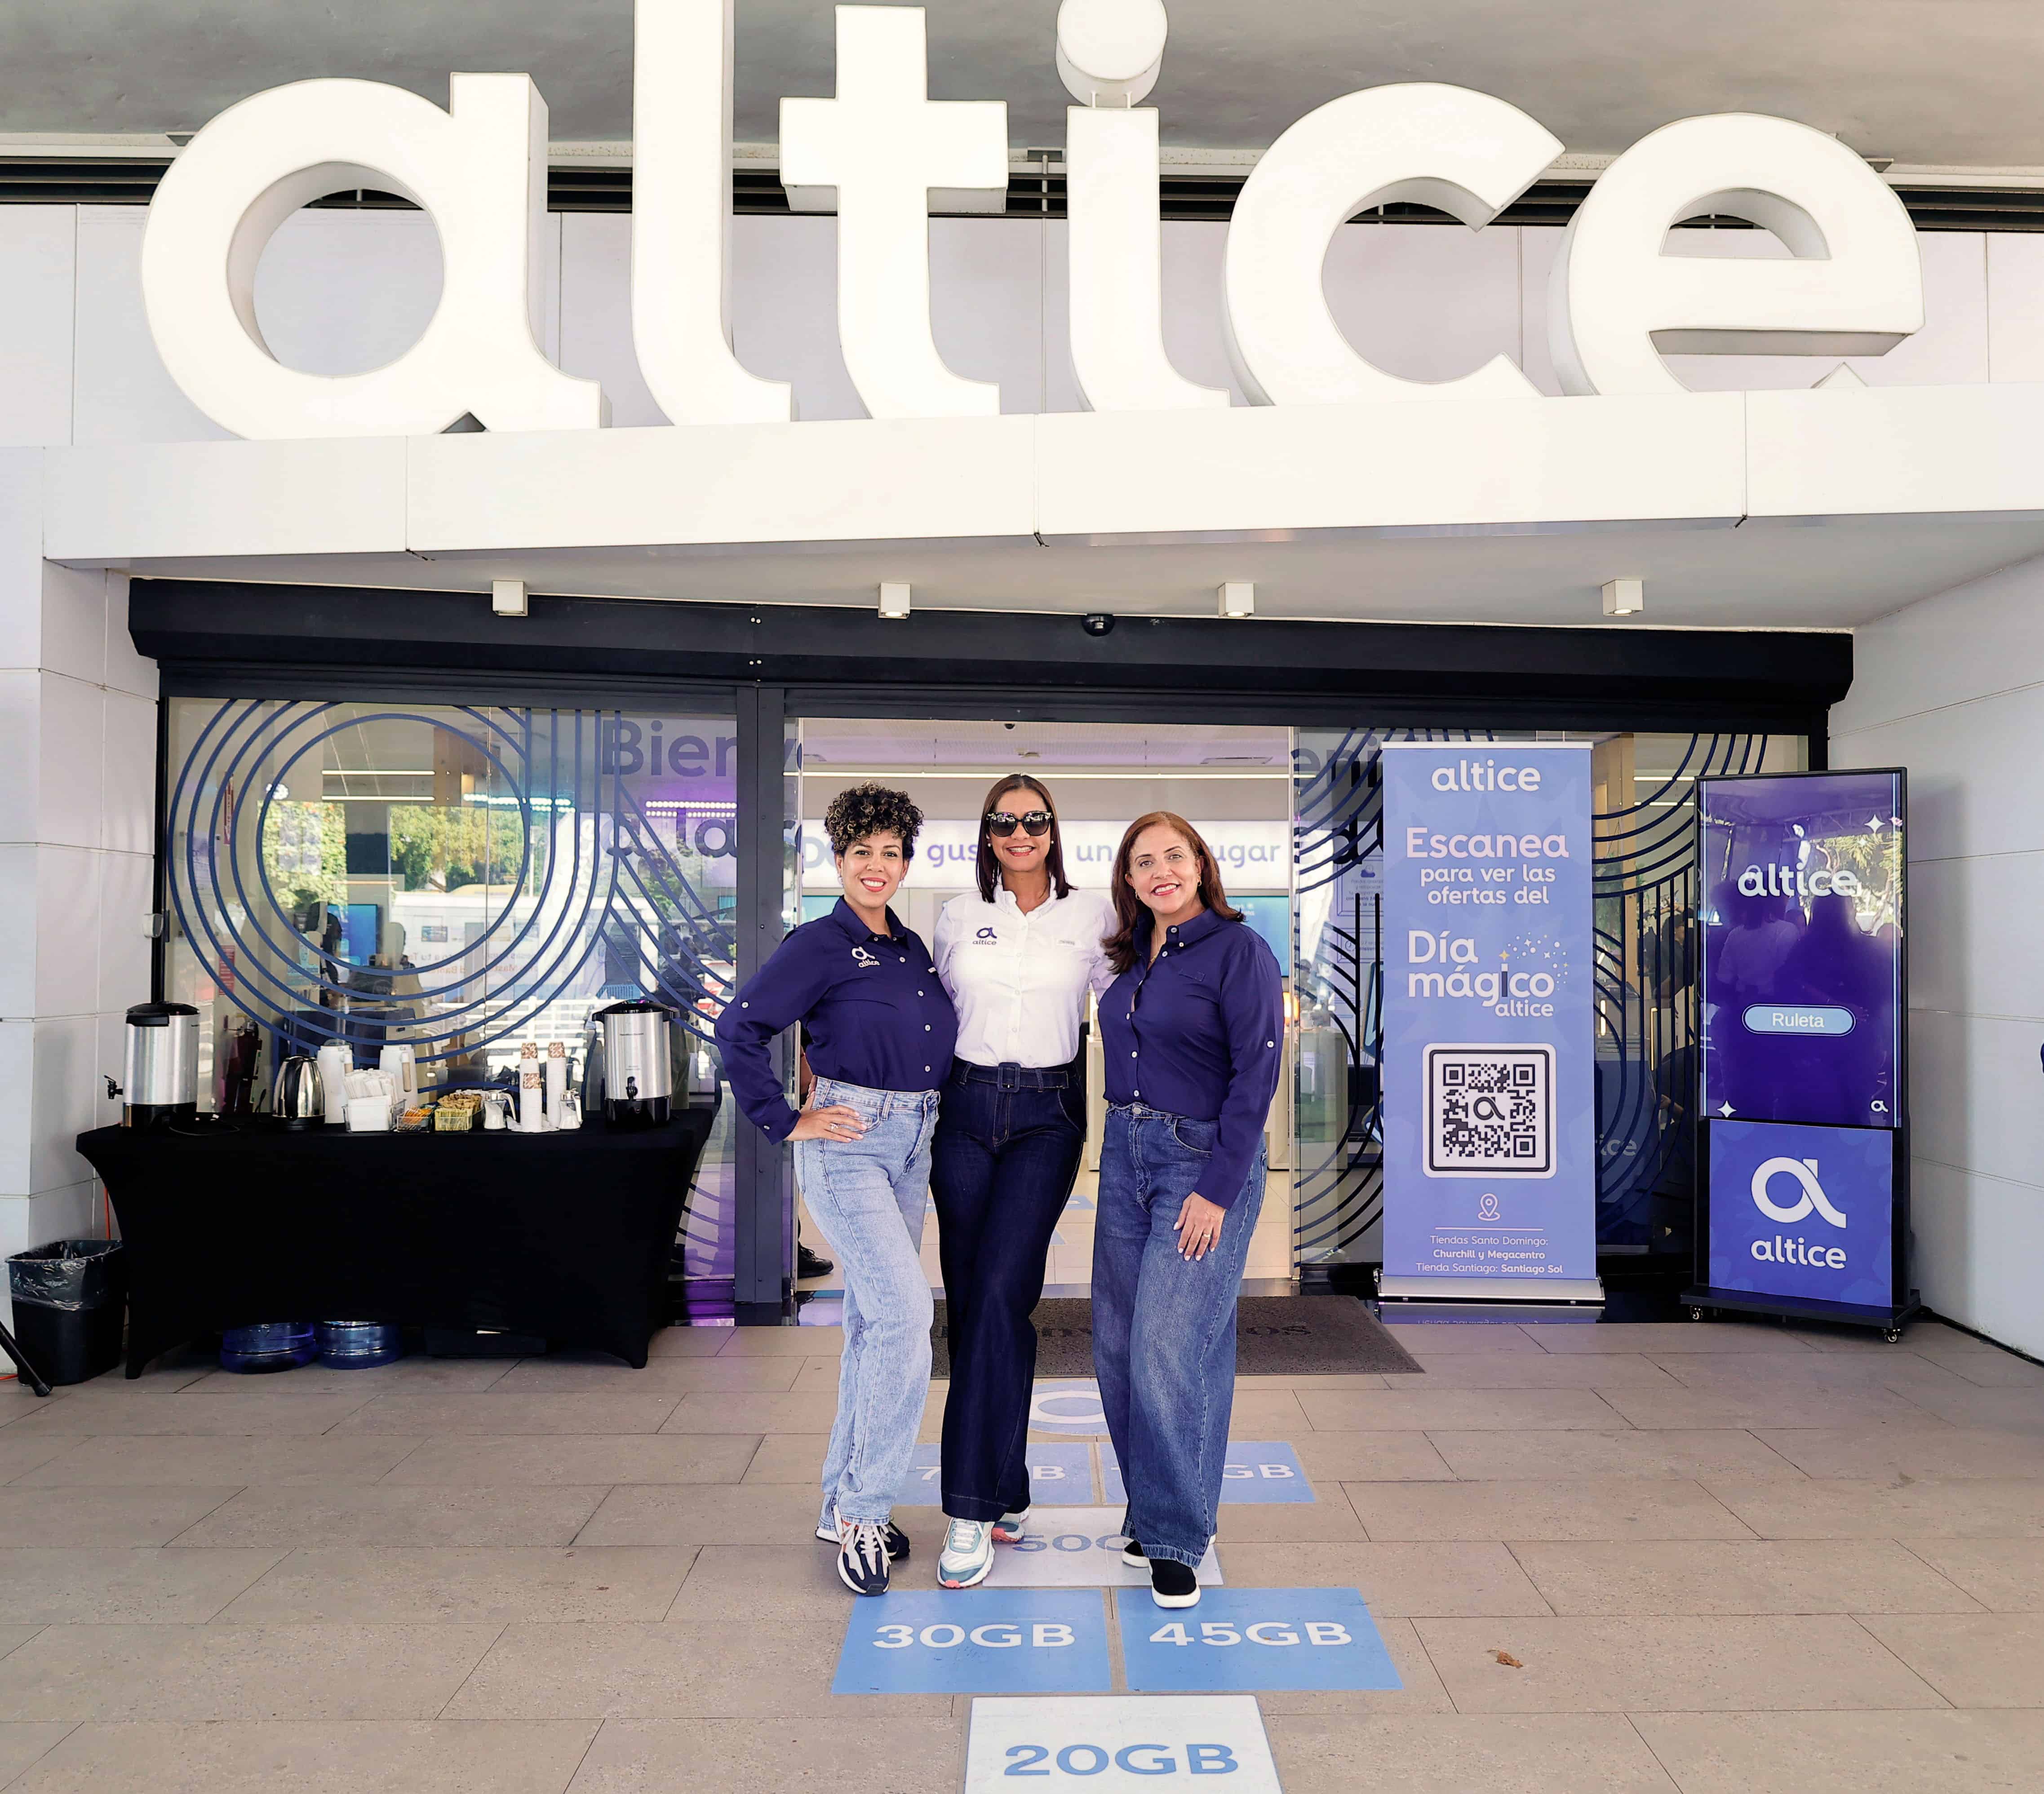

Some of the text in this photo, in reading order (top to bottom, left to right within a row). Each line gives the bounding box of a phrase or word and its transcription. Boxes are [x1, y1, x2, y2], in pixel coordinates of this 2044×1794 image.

[141, 0, 1925, 443] altice
[1432, 759, 1541, 792] altice
[1406, 827, 1569, 858] Escanea
[1420, 864, 1556, 887] para ver las
[1737, 862, 1858, 897] altice
[1427, 886, 1549, 904] ofertas del
[1408, 930, 1479, 964] Día
[859, 955, 880, 967] altice
[1408, 964, 1555, 1007] mágico
[1495, 999, 1554, 1017] altice
[1772, 1012, 1825, 1029] Ruleta
[1430, 1236, 1548, 1247] Tiendas Santo Domingo:
[1751, 1236, 1847, 1269] altice
[1433, 1249, 1545, 1261] Churchill y Megacentro
[1416, 1263, 1563, 1275] Tienda Santiago: Santiago Sol
[872, 1623, 1076, 1648] 30GB
[1149, 1621, 1352, 1647] 45GB
[1004, 1744, 1239, 1776] 20GB
